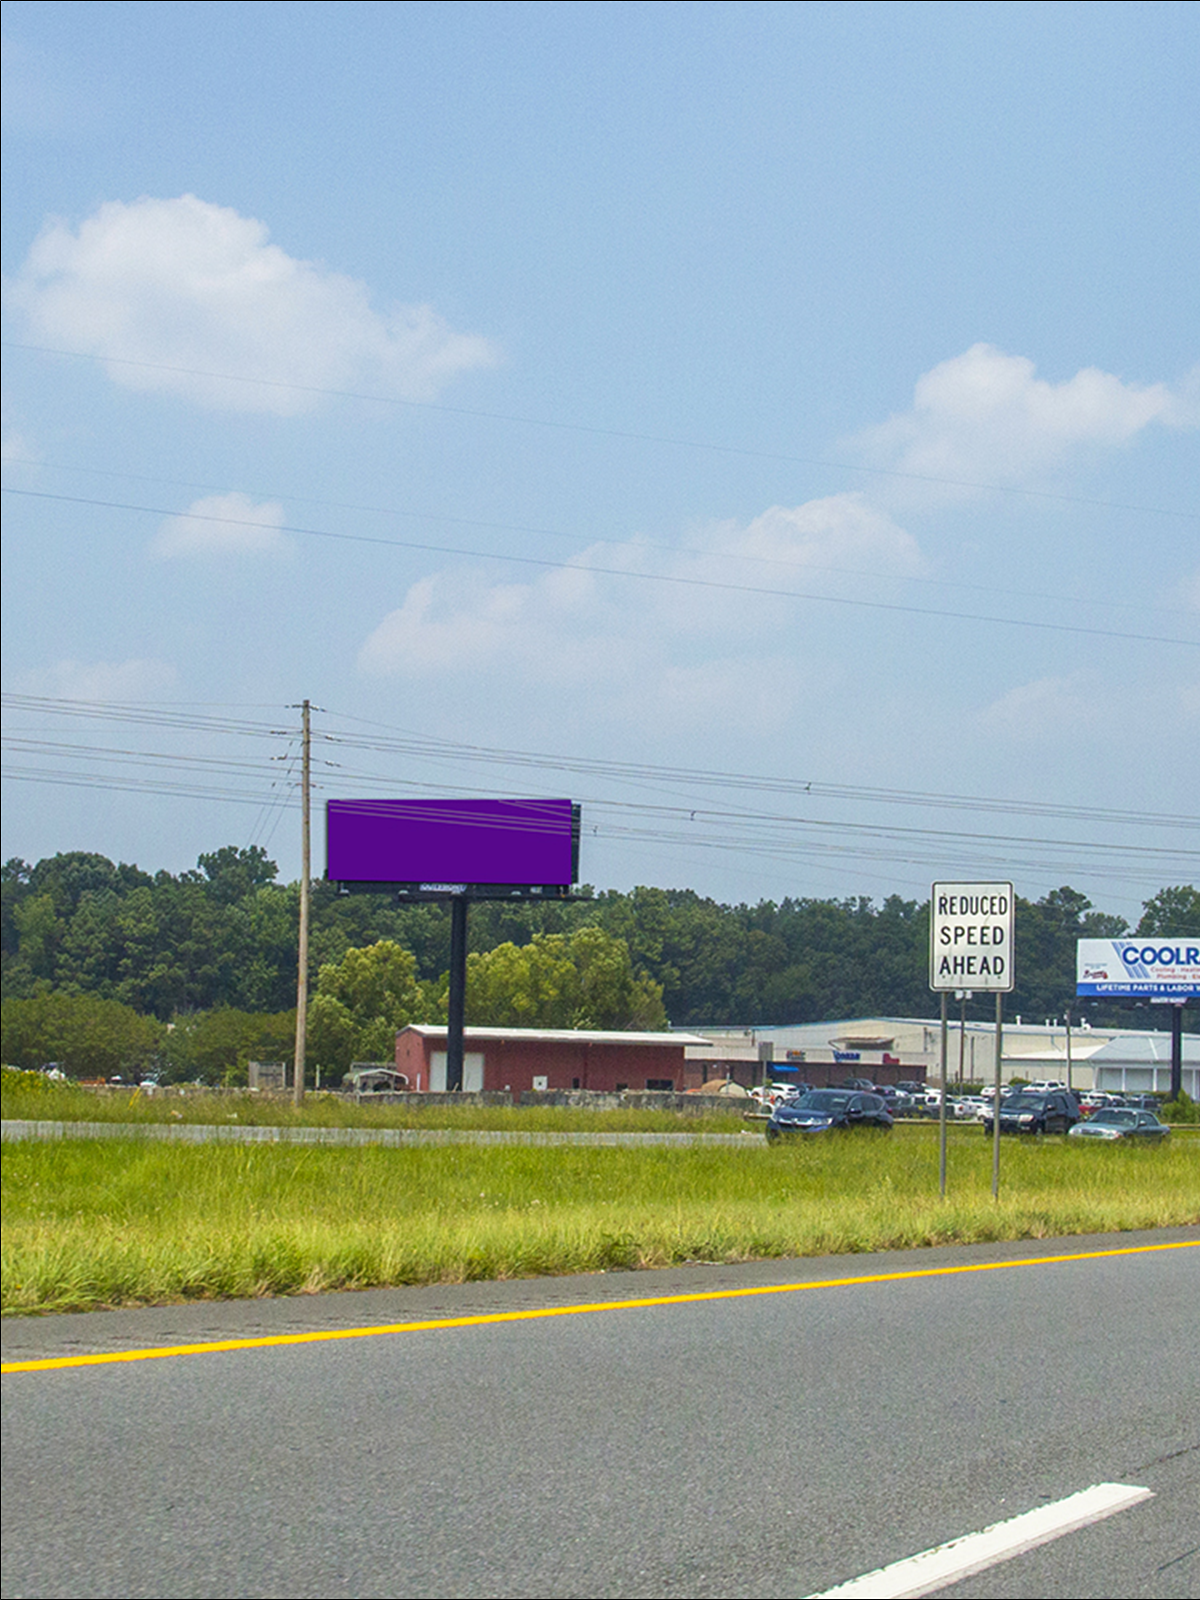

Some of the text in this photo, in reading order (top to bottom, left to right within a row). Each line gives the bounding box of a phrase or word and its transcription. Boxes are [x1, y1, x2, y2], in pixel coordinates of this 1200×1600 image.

[939, 896, 1008, 915] REDUCED
[940, 926, 1004, 945] SPEED
[939, 956, 1005, 975] AHEAD
[1150, 966, 1175, 974] Cooling
[1096, 984, 1131, 992] LIFETIME
[1133, 984, 1157, 992] PARTS
[1166, 984, 1194, 992] LABOR
